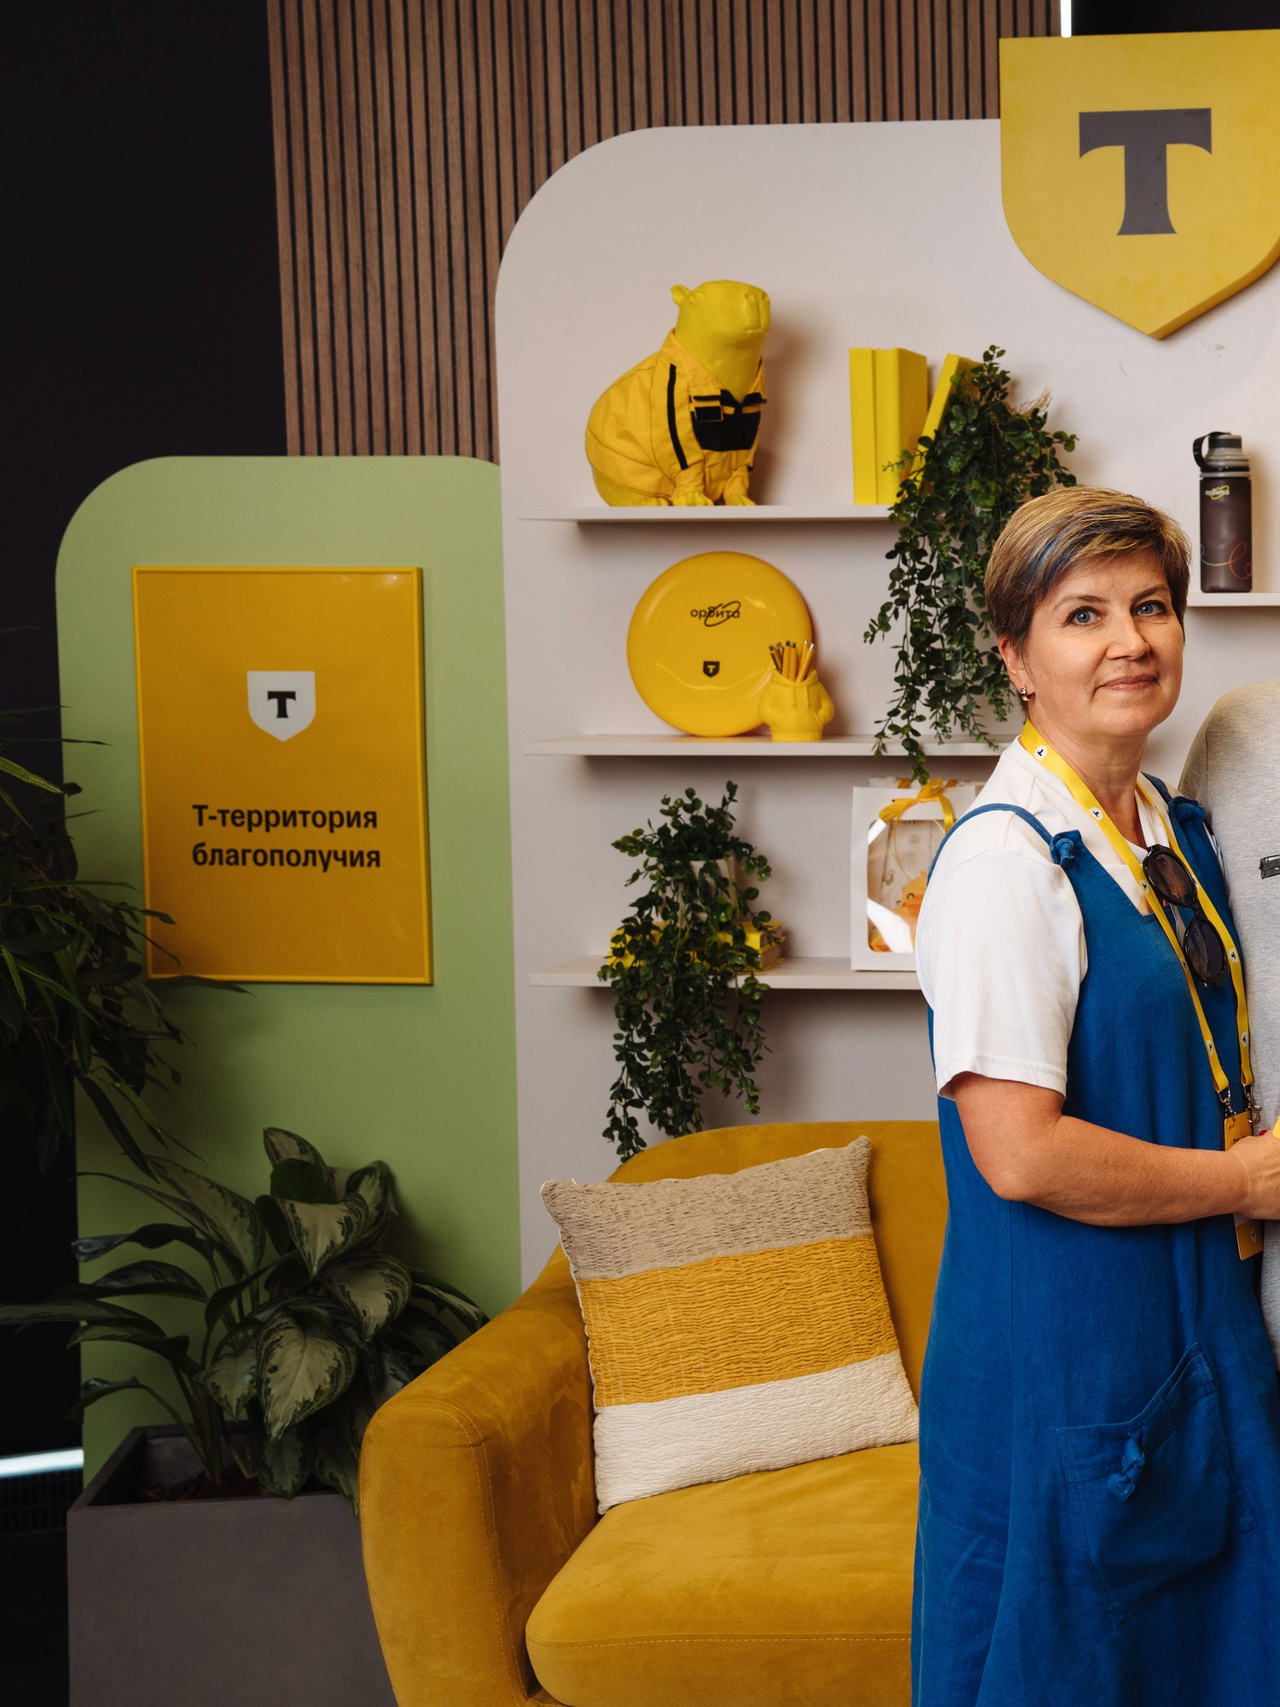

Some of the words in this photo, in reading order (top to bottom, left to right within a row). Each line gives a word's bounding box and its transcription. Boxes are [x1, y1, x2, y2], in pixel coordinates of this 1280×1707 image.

[1079, 107, 1212, 236] Т
[267, 690, 297, 719] Т
[191, 804, 378, 834] Т-территория
[191, 842, 382, 873] благополучия
